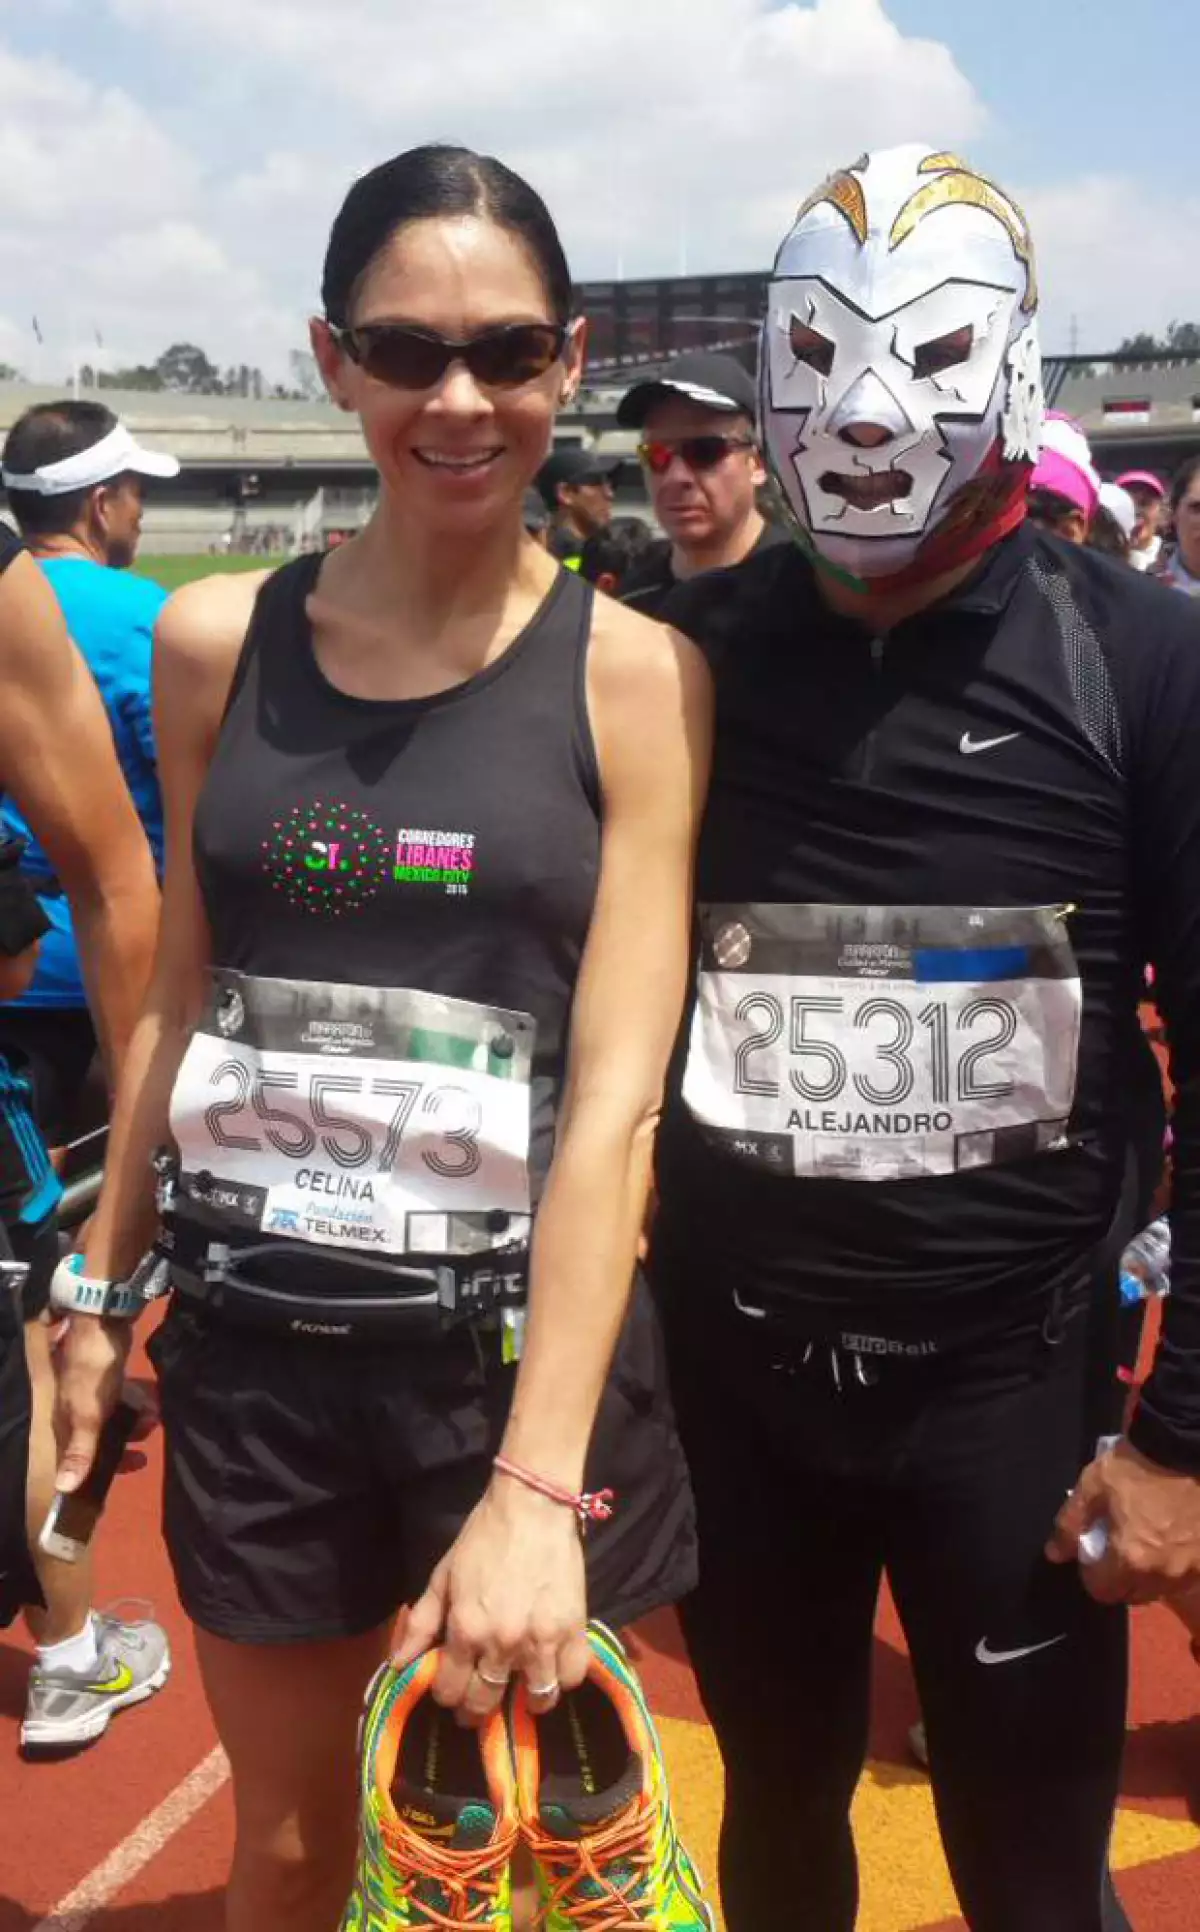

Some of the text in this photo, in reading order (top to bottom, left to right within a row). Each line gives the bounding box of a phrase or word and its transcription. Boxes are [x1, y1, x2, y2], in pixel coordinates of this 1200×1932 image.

[398, 829, 475, 848] CORREDORES
[733, 990, 1017, 1106] 25312
[204, 1058, 483, 1178] 25573
[786, 1109, 953, 1134] ALEJANDRO
[294, 1168, 376, 1203] CELINA
